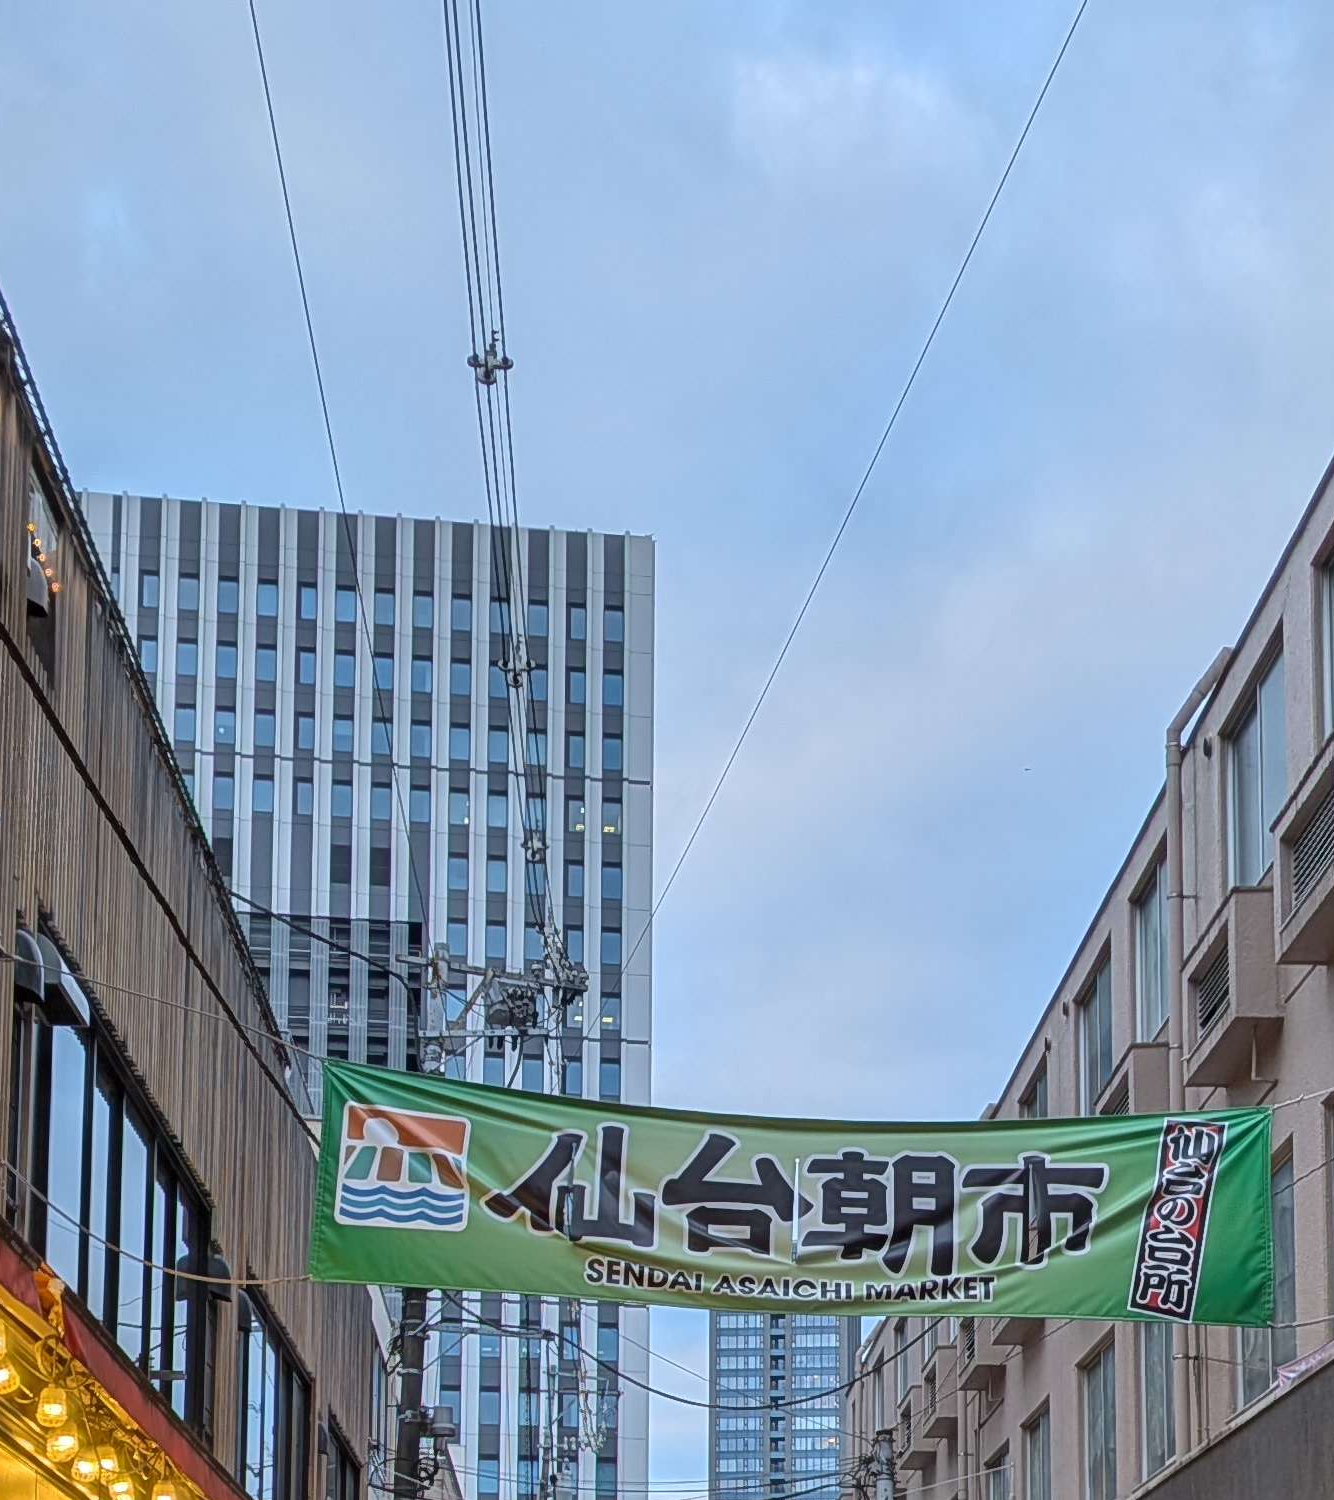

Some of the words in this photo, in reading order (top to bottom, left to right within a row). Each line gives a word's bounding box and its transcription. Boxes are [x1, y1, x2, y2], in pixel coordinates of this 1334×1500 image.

[484, 1122, 1110, 1278] 仙台朝市
[1134, 1125, 1218, 1314] 仙台の台所
[585, 1257, 704, 1293] SENDAI
[712, 1272, 854, 1303] ASAICHI
[865, 1274, 996, 1304] MARKET
